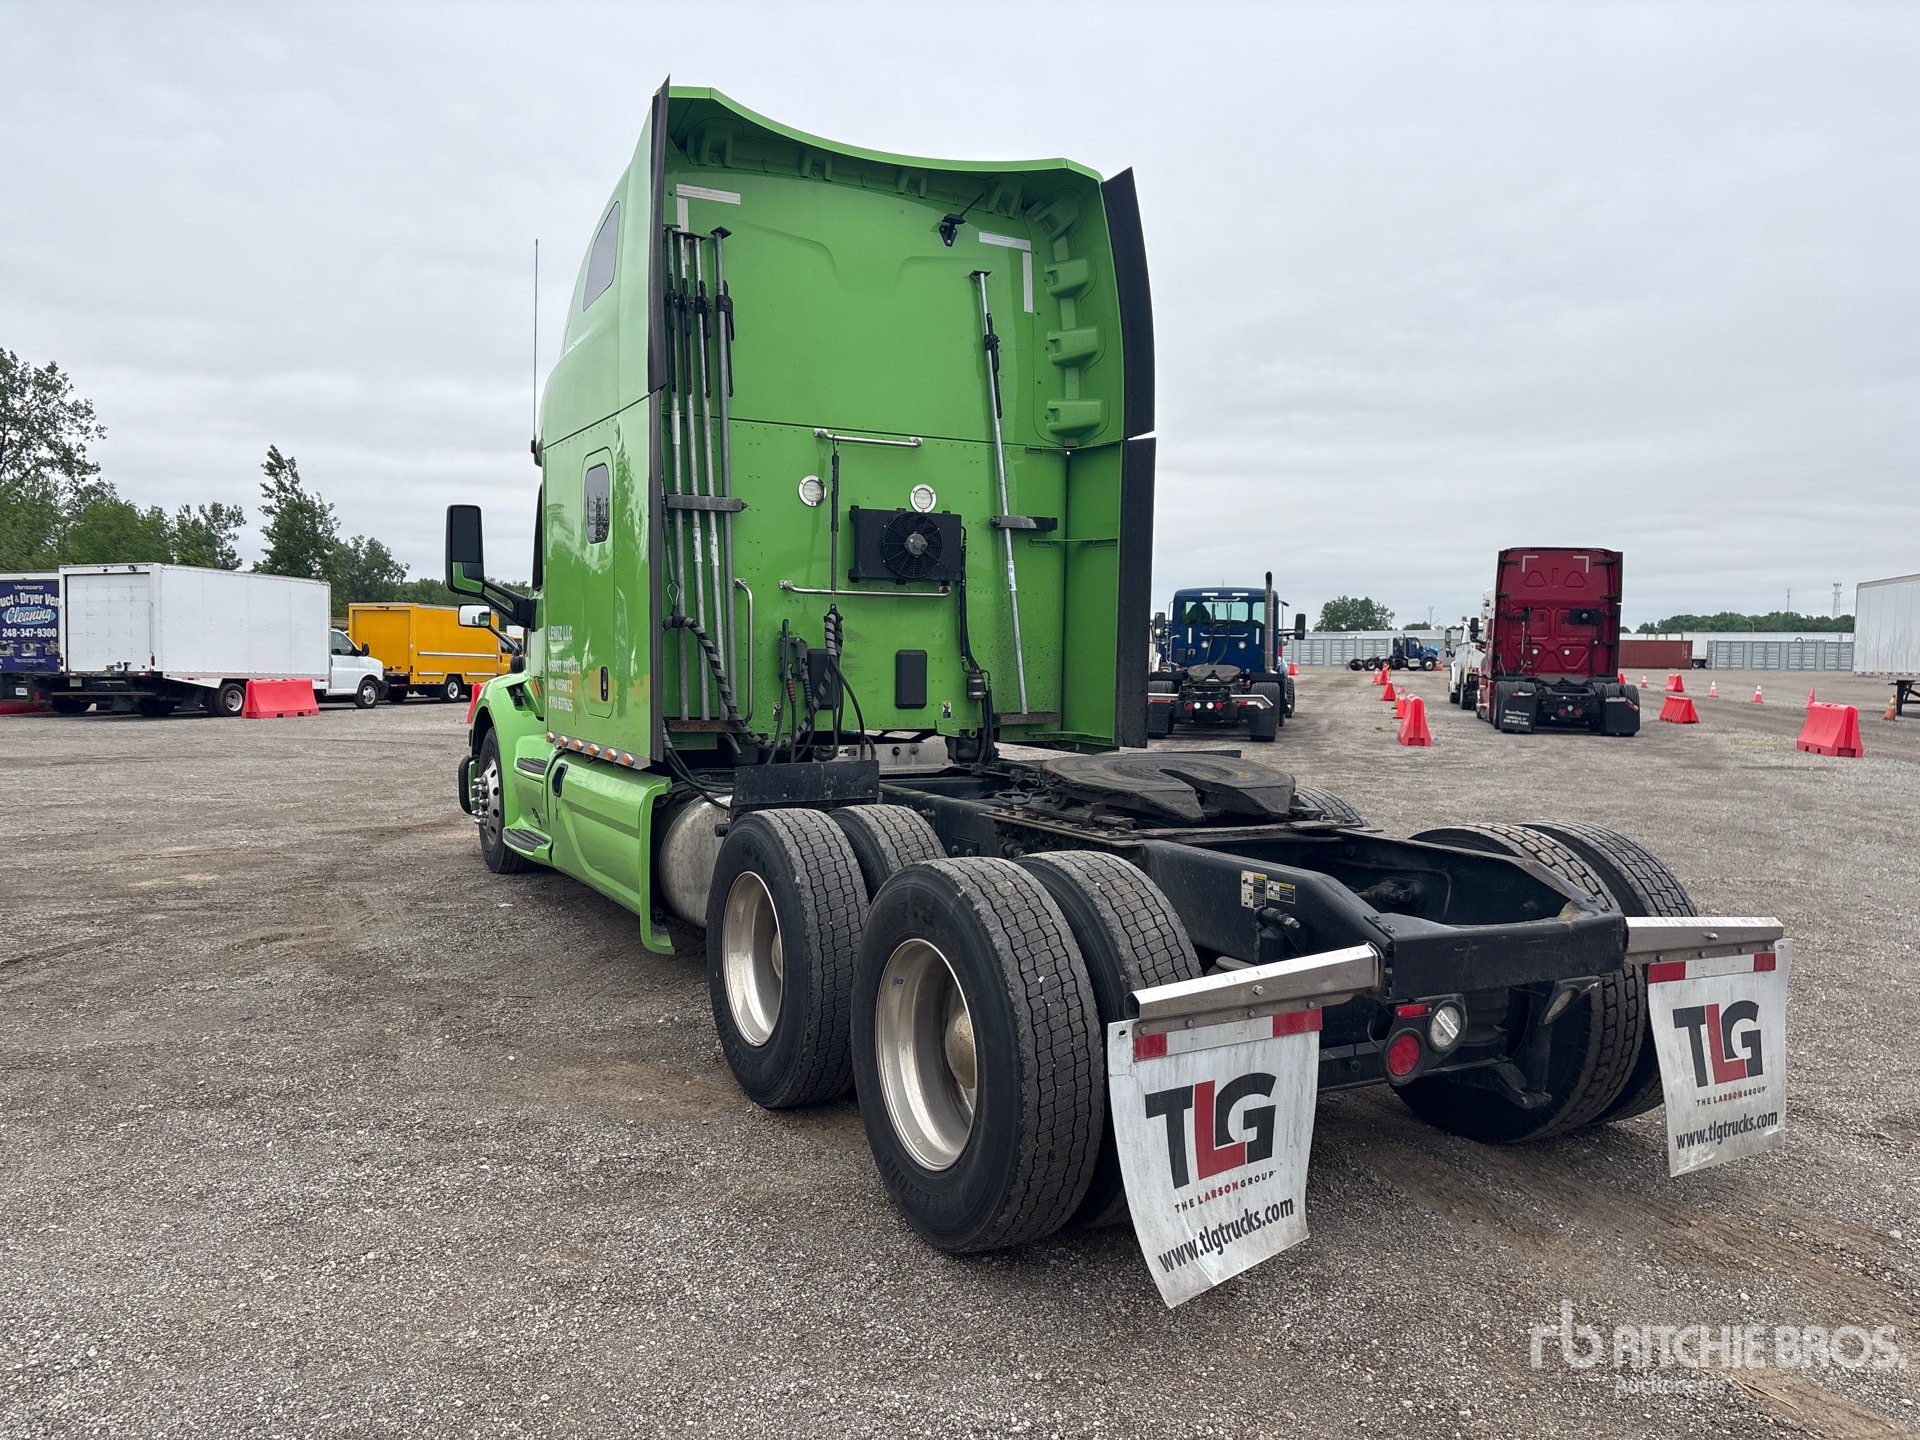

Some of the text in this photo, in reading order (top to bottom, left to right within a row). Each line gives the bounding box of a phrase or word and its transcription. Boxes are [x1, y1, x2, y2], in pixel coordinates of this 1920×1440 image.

[20, 592, 43, 605] Dryer
[6, 606, 52, 624] Cleaning
[2, 628, 57, 637] 248-347-9300
[563, 626, 573, 640] LLC
[548, 660, 562, 673] USDOT
[1672, 1000, 1764, 1088] TLG
[1696, 1097, 1711, 1107] THE
[1144, 1072, 1278, 1190] TLG
[1675, 1110, 1779, 1150] www.tlgtrucks.com
[1174, 1198, 1195, 1214] THE
[1158, 1198, 1295, 1273] www.tlgtrucks.com
